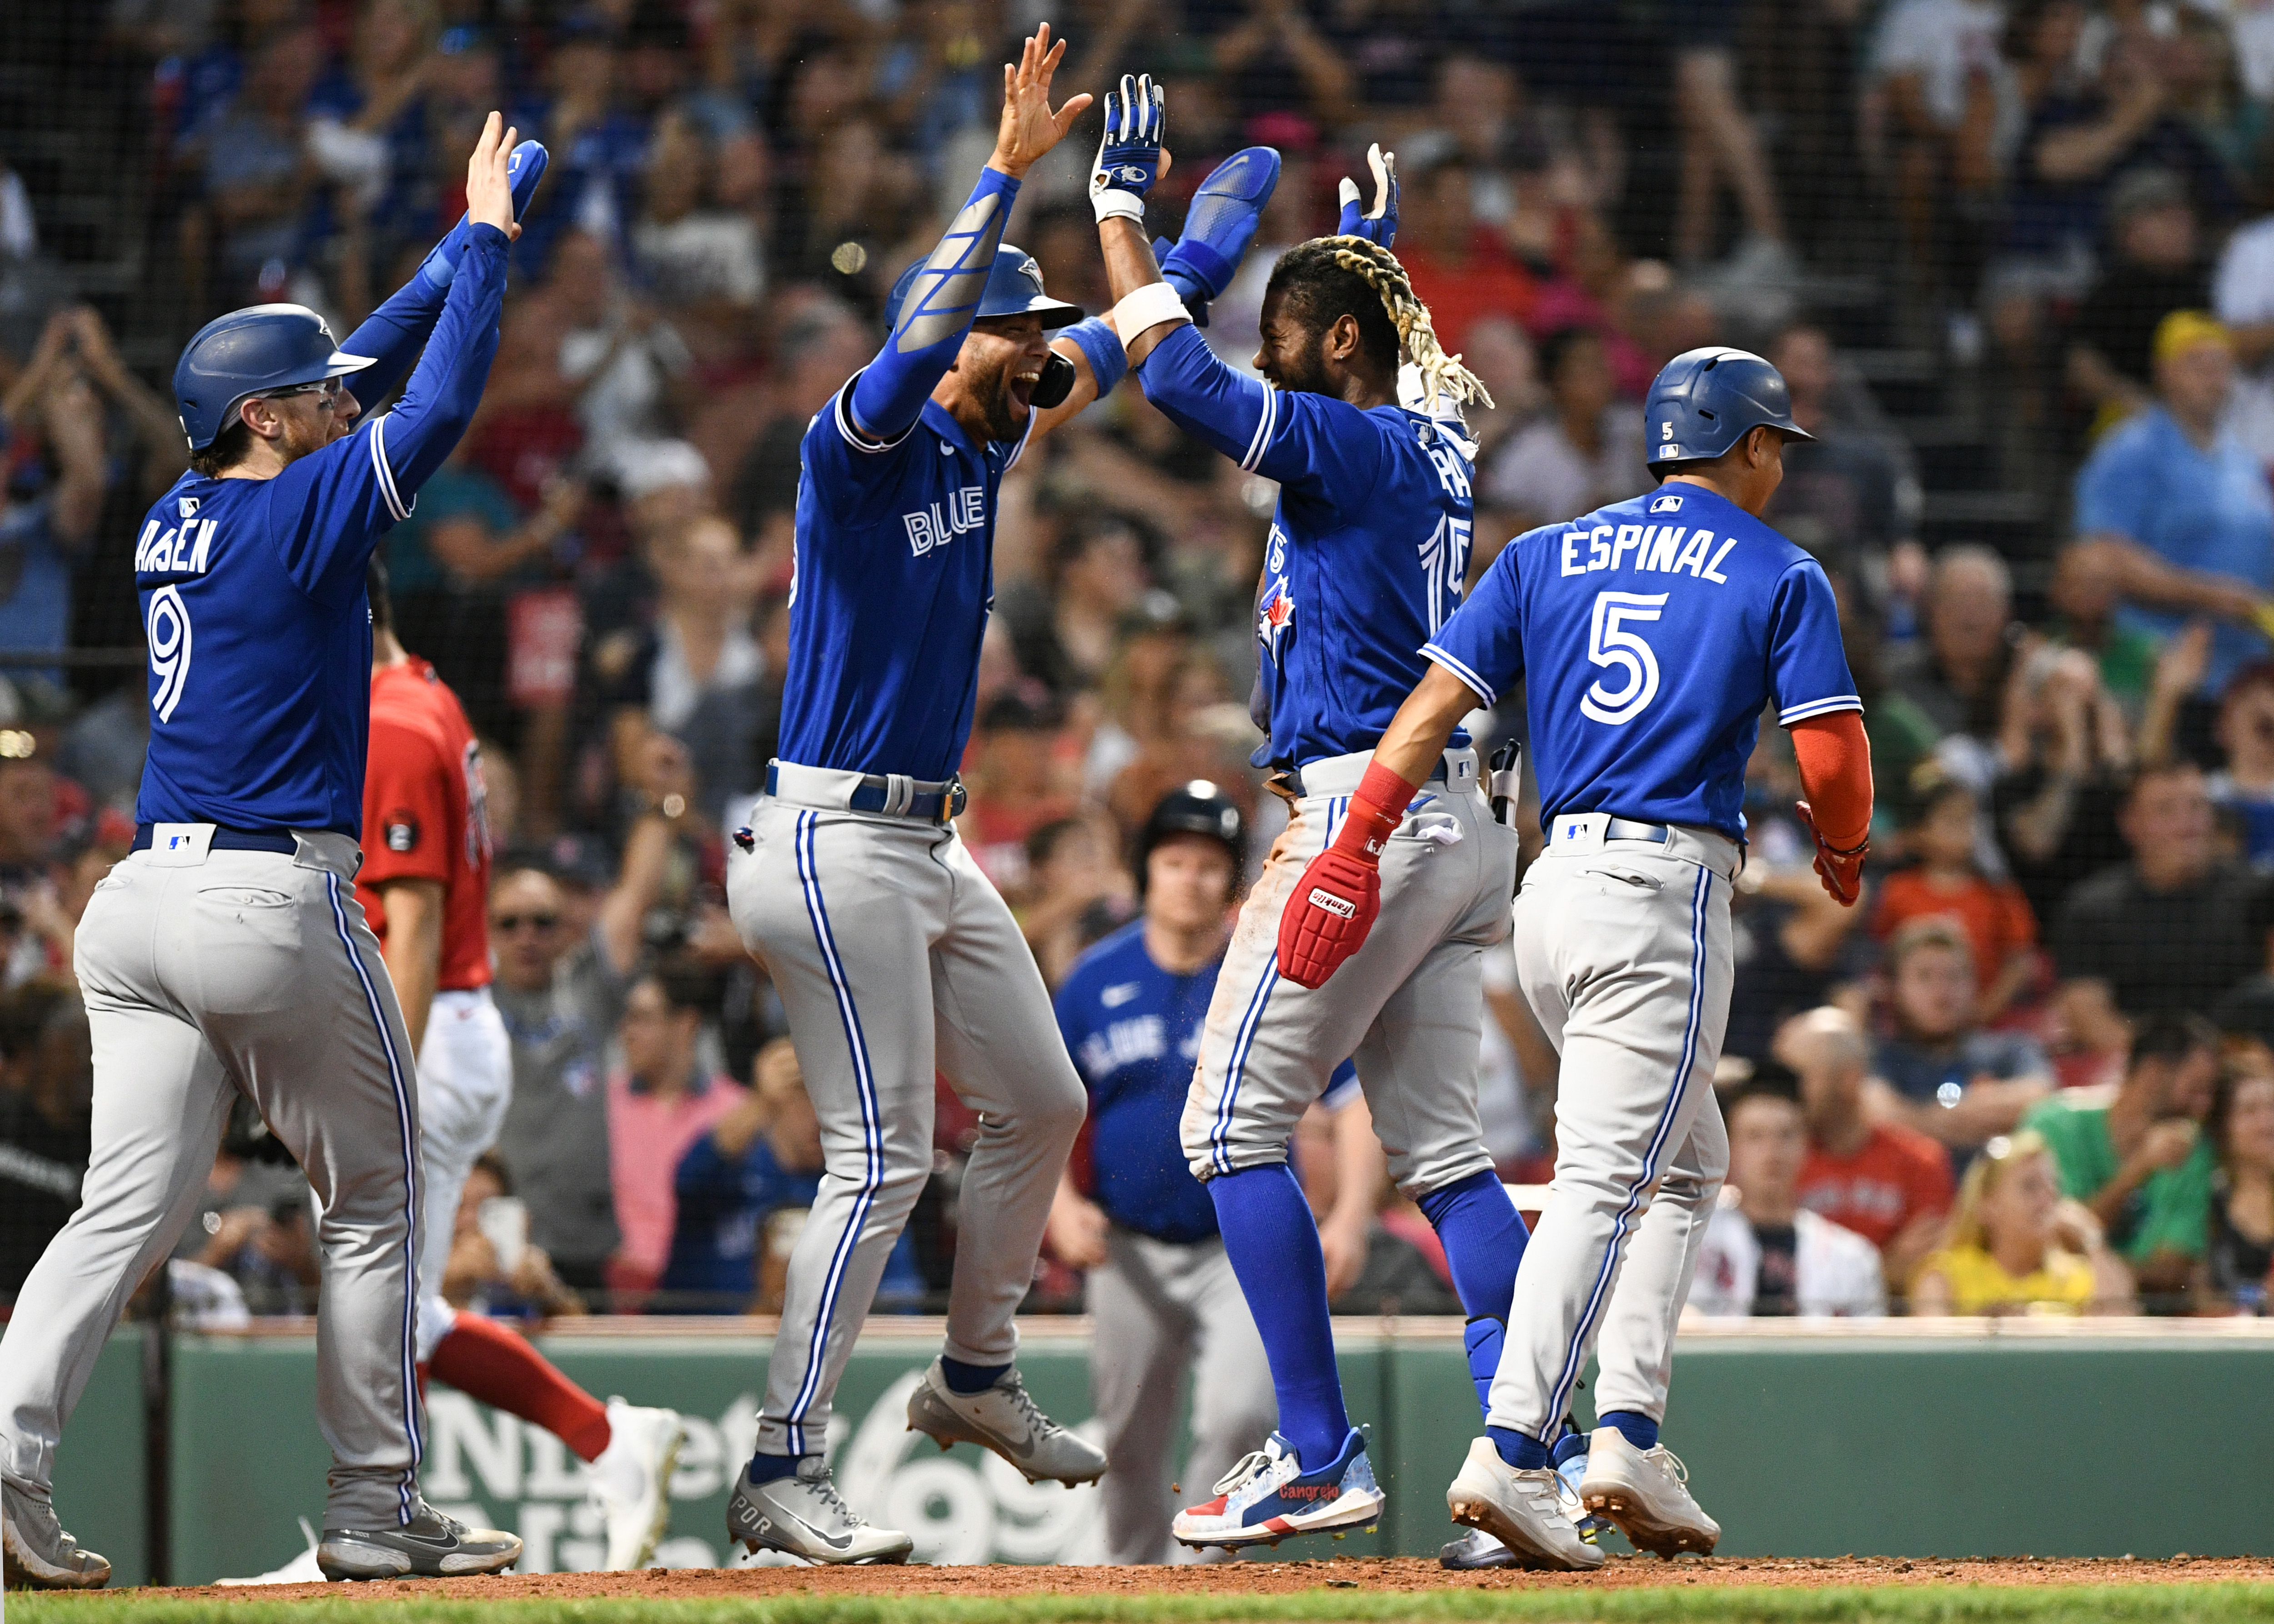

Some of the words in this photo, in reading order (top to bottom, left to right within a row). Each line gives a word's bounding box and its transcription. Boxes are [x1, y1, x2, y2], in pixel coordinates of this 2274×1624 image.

[1662, 421, 1674, 441] 5
[902, 486, 985, 557] BLUE
[1561, 524, 1737, 585] ESPINAL
[147, 583, 192, 724] 9
[1580, 591, 1669, 725] 5
[731, 1495, 772, 1535] POR
[1279, 1483, 1339, 1502] Cangrejo
